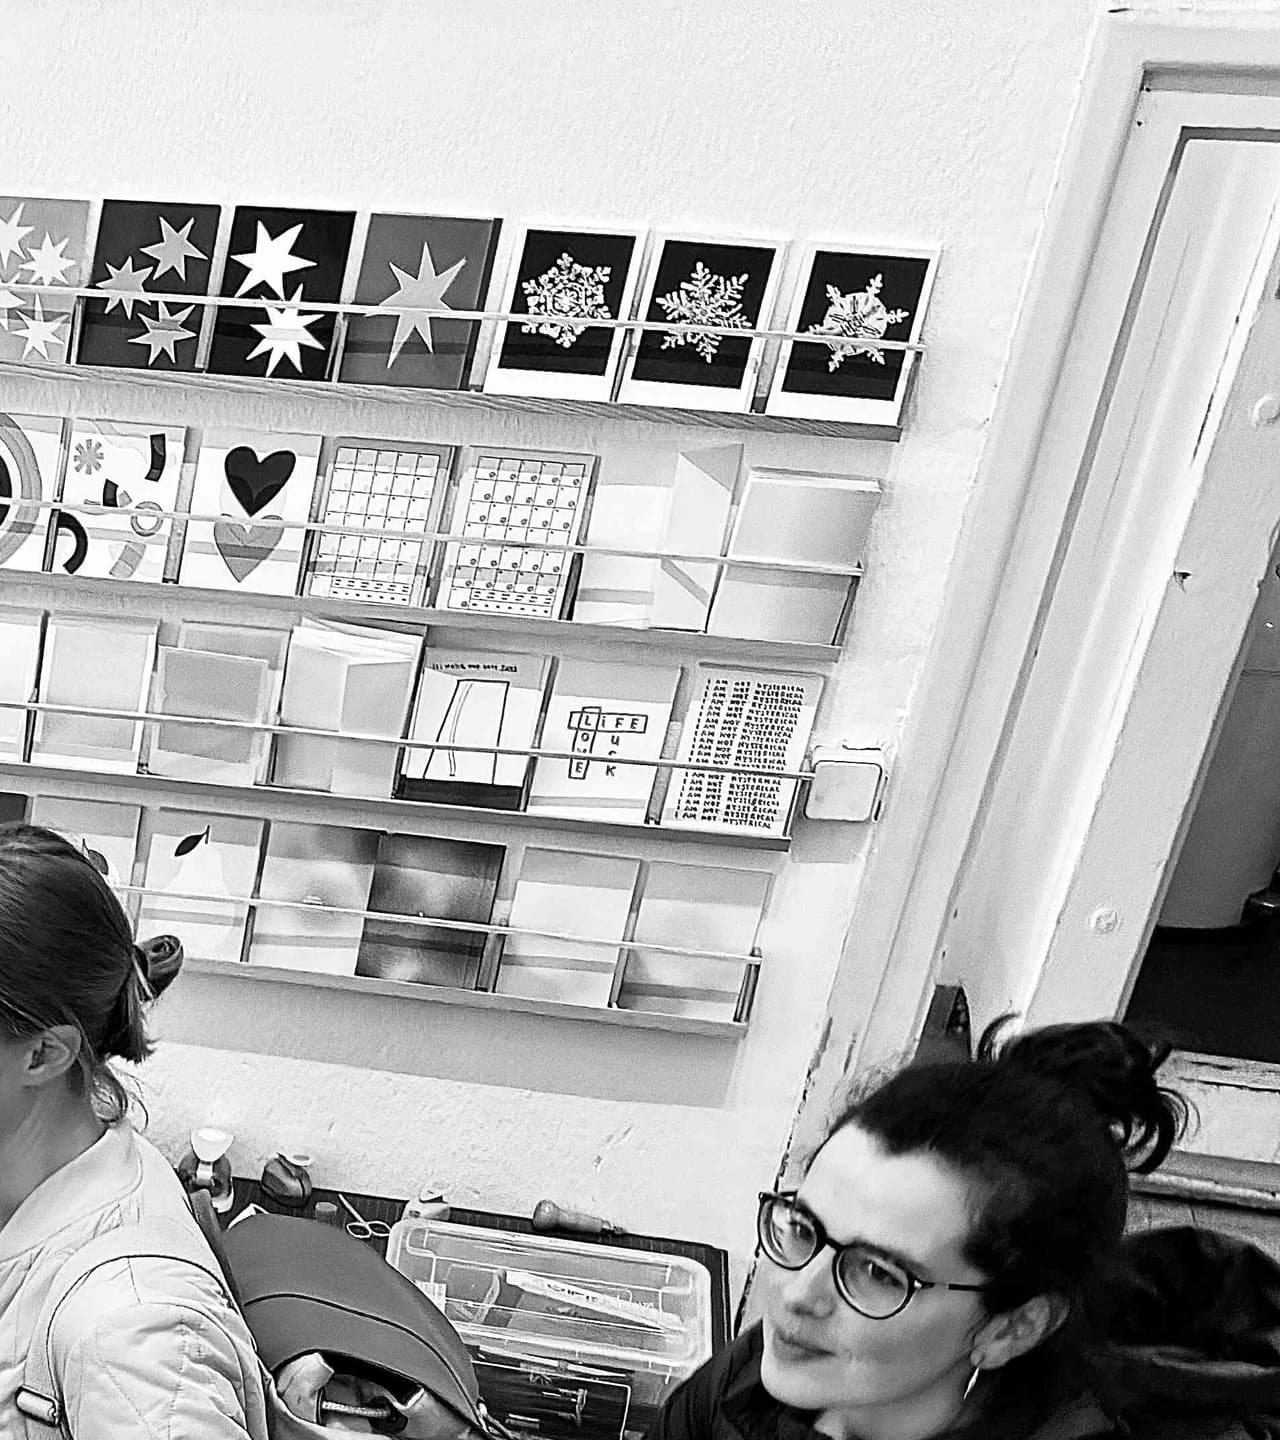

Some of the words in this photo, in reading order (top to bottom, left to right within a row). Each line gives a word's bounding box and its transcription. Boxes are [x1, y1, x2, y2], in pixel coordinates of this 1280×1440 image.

[712, 691, 726, 699] AM
[710, 698, 724, 706] AM
[706, 710, 721, 718] AM
[705, 717, 719, 725] AM
[699, 737, 714, 745] AM
[698, 743, 712, 751] AM
[691, 771, 706, 779] AM
[690, 778, 703, 786] AM
[682, 812, 697, 820] AM
